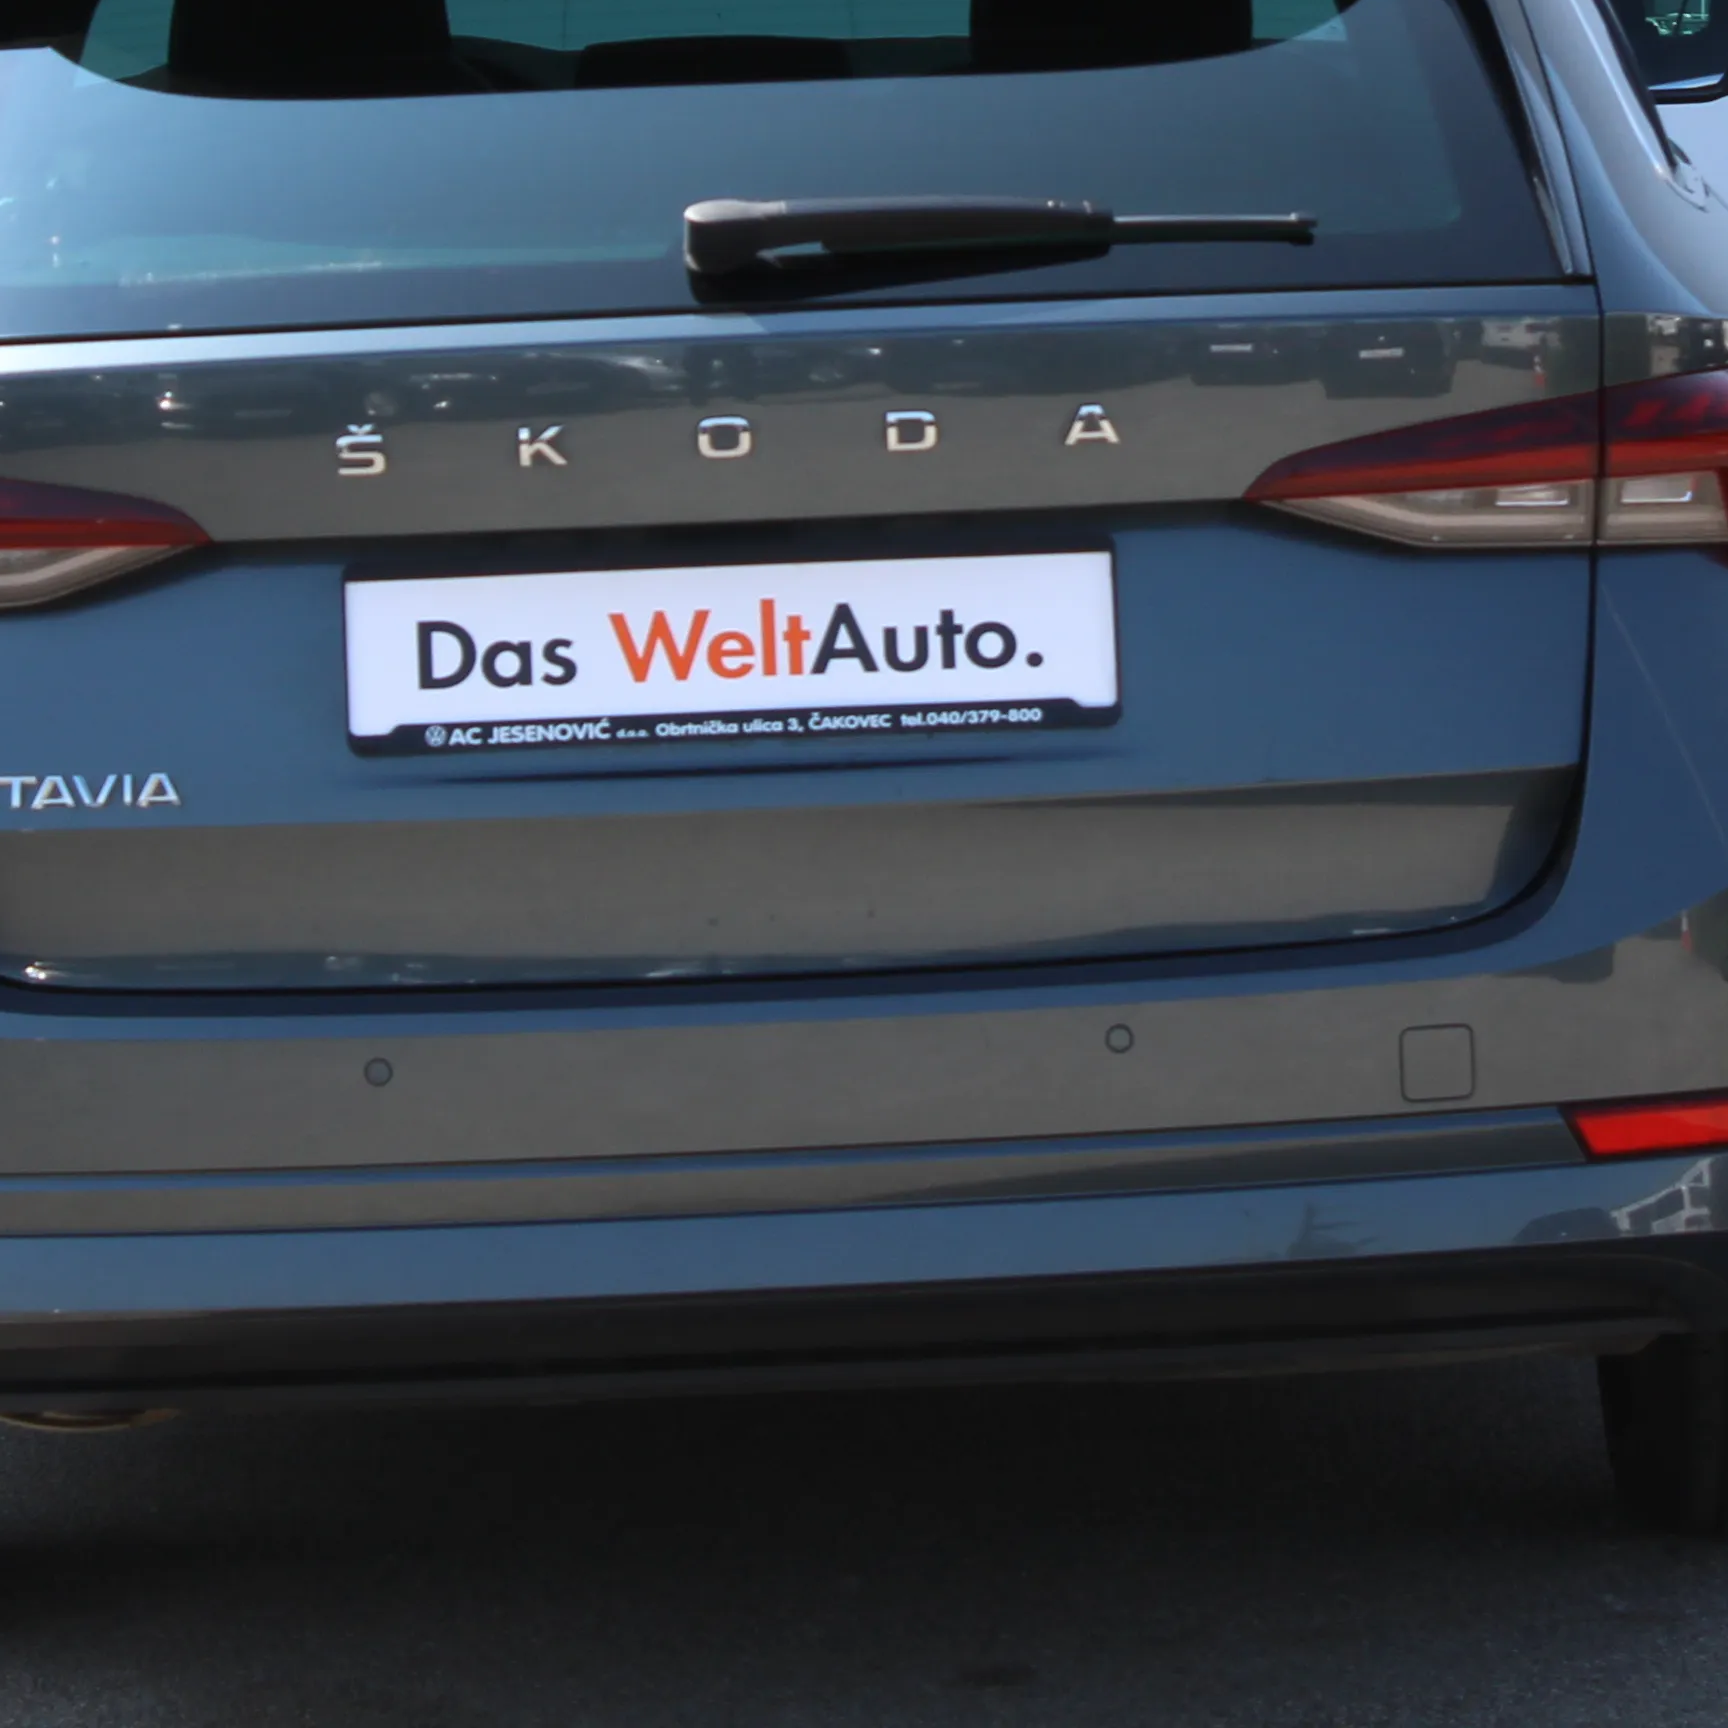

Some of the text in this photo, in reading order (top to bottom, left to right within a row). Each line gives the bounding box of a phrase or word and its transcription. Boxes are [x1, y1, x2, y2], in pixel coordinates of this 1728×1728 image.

[335, 402, 1121, 476] ŠKODA
[416, 598, 1045, 690] Das WeltAuto.
[449, 726, 483, 746] AC
[487, 717, 612, 744] JESENOVIĆ
[655, 719, 739, 737] Obrtnička
[742, 718, 784, 734] ulica
[808, 711, 892, 731] ČAKOVEC
